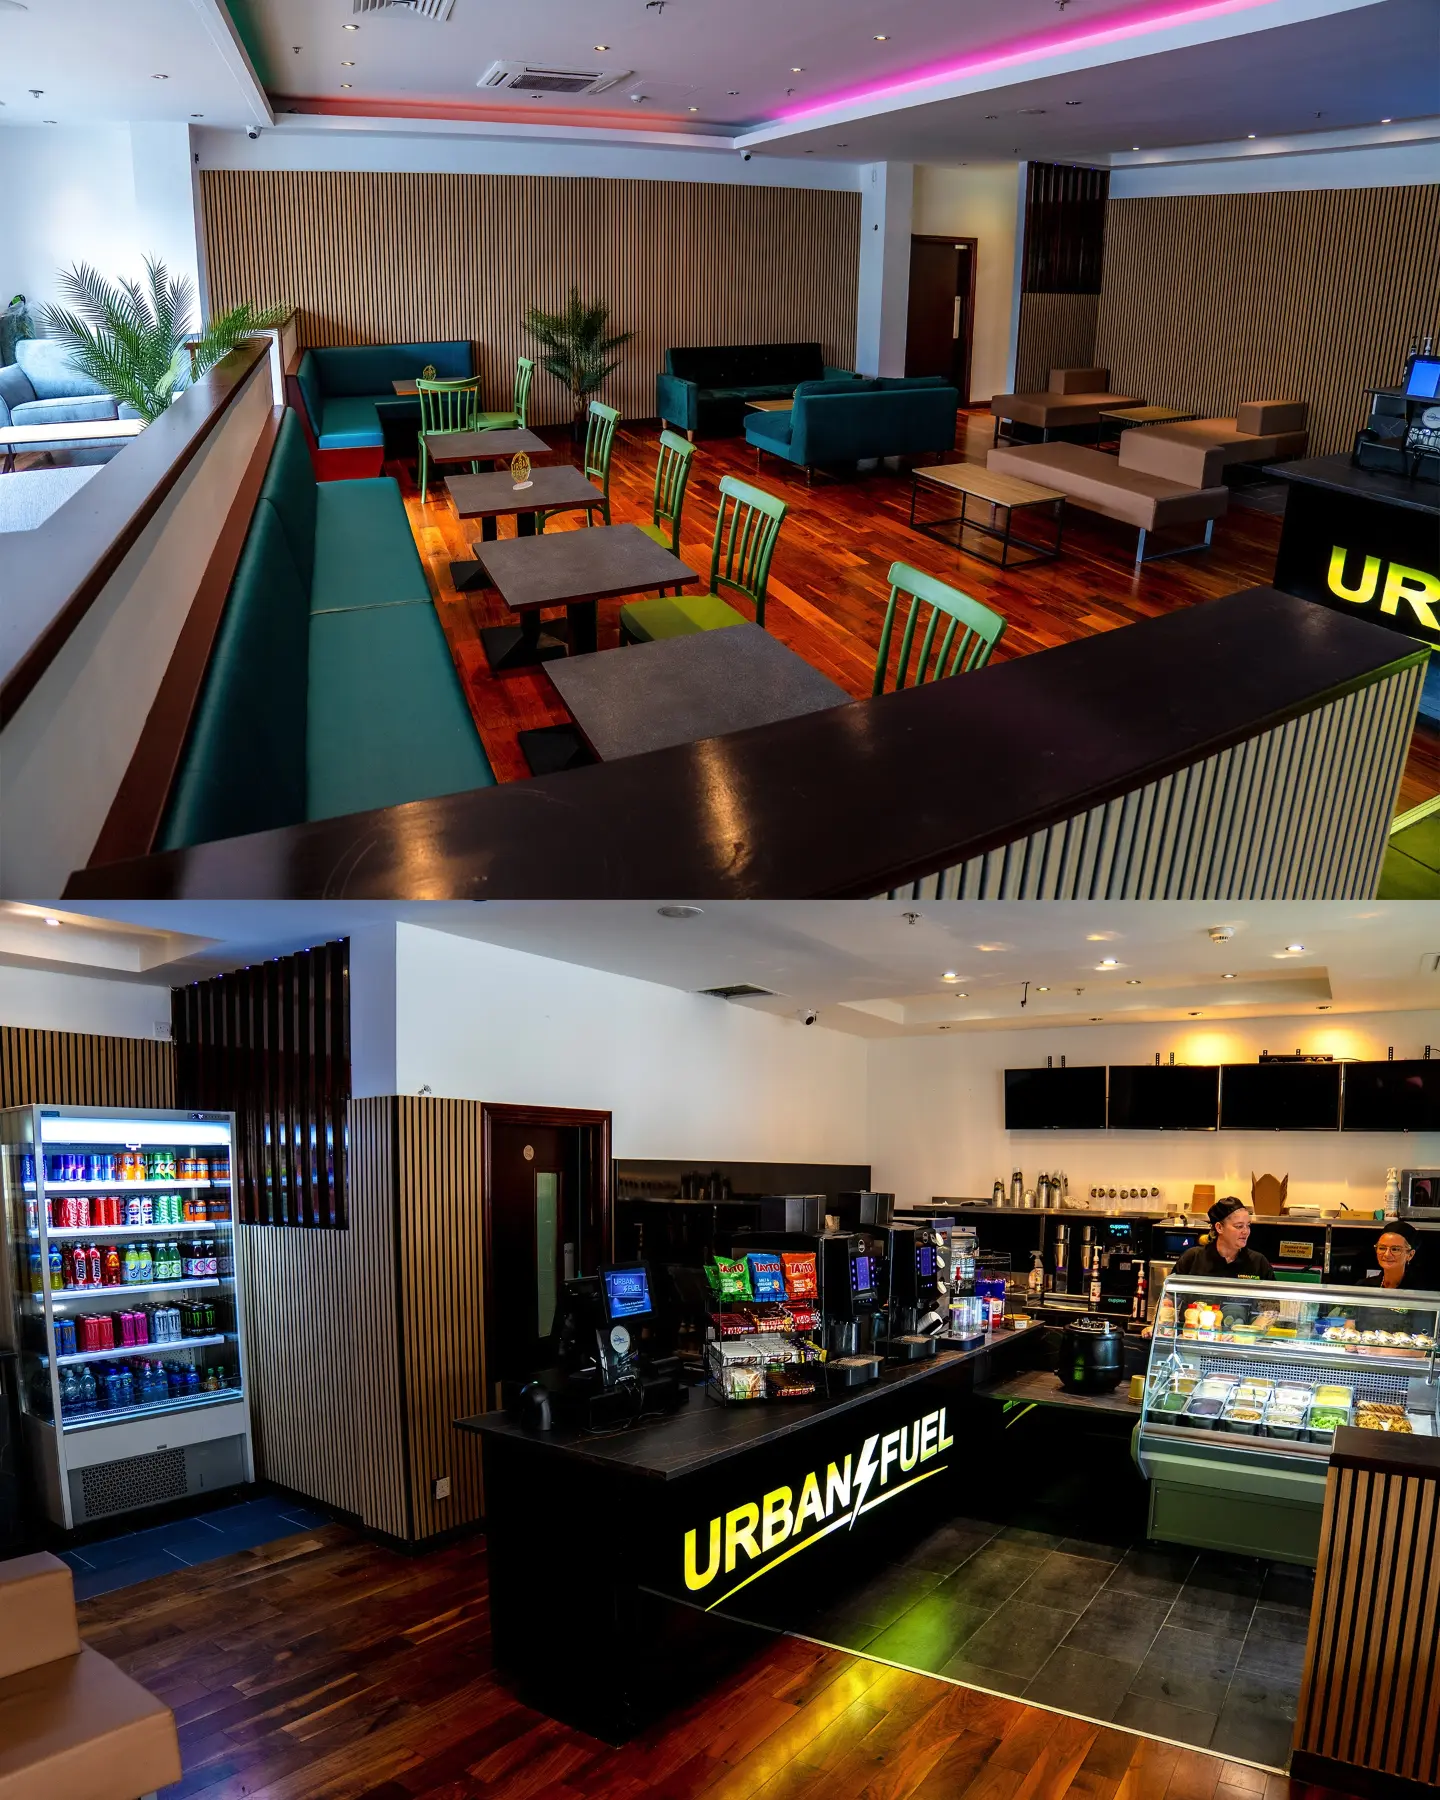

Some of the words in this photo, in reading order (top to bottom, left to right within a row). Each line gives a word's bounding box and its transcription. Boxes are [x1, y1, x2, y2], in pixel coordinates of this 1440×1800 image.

[719, 1263, 744, 1273] TAYTO
[754, 1262, 780, 1272] TAYTO
[790, 1263, 813, 1273] TAYTO
[684, 1453, 852, 1591] URBAN
[880, 1407, 954, 1486] FUEL
